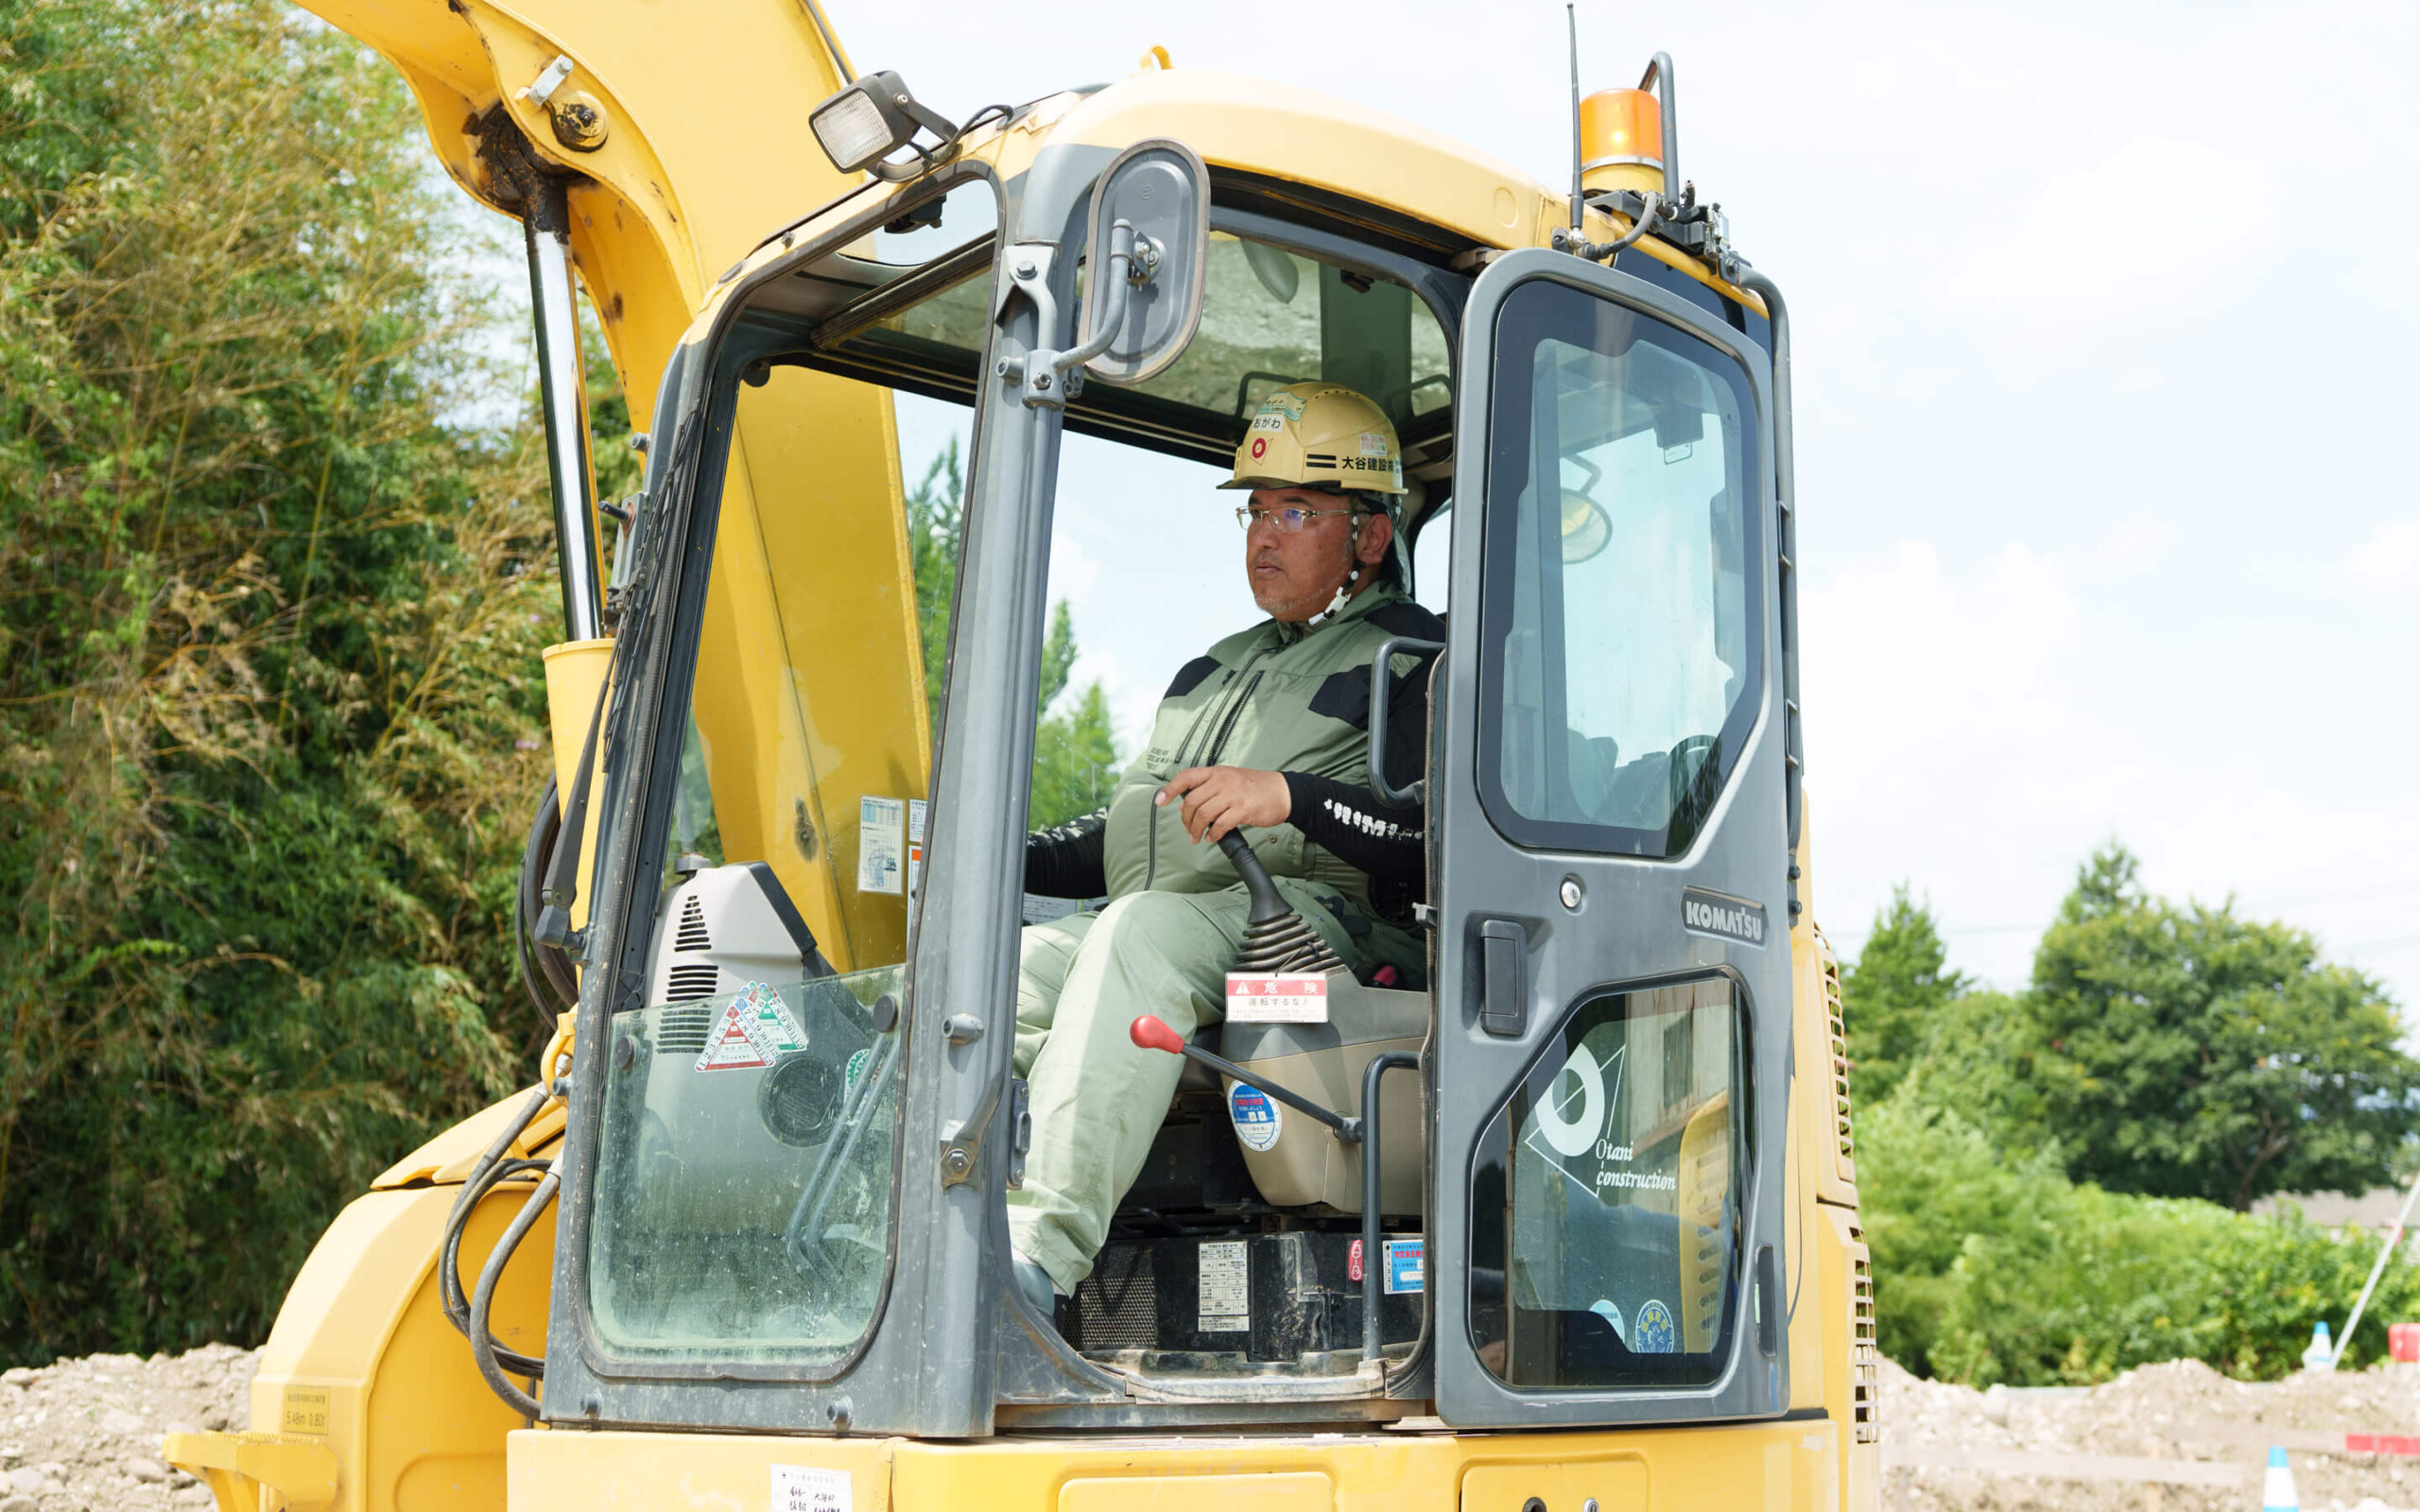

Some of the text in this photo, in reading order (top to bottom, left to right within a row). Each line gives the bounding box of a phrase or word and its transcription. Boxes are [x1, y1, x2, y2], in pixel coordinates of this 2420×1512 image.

[1253, 418, 1281, 429] おがわ
[1685, 901, 1762, 940] KOMATSU
[1596, 1139, 1634, 1161] Otani
[1596, 1168, 1676, 1191] construction
